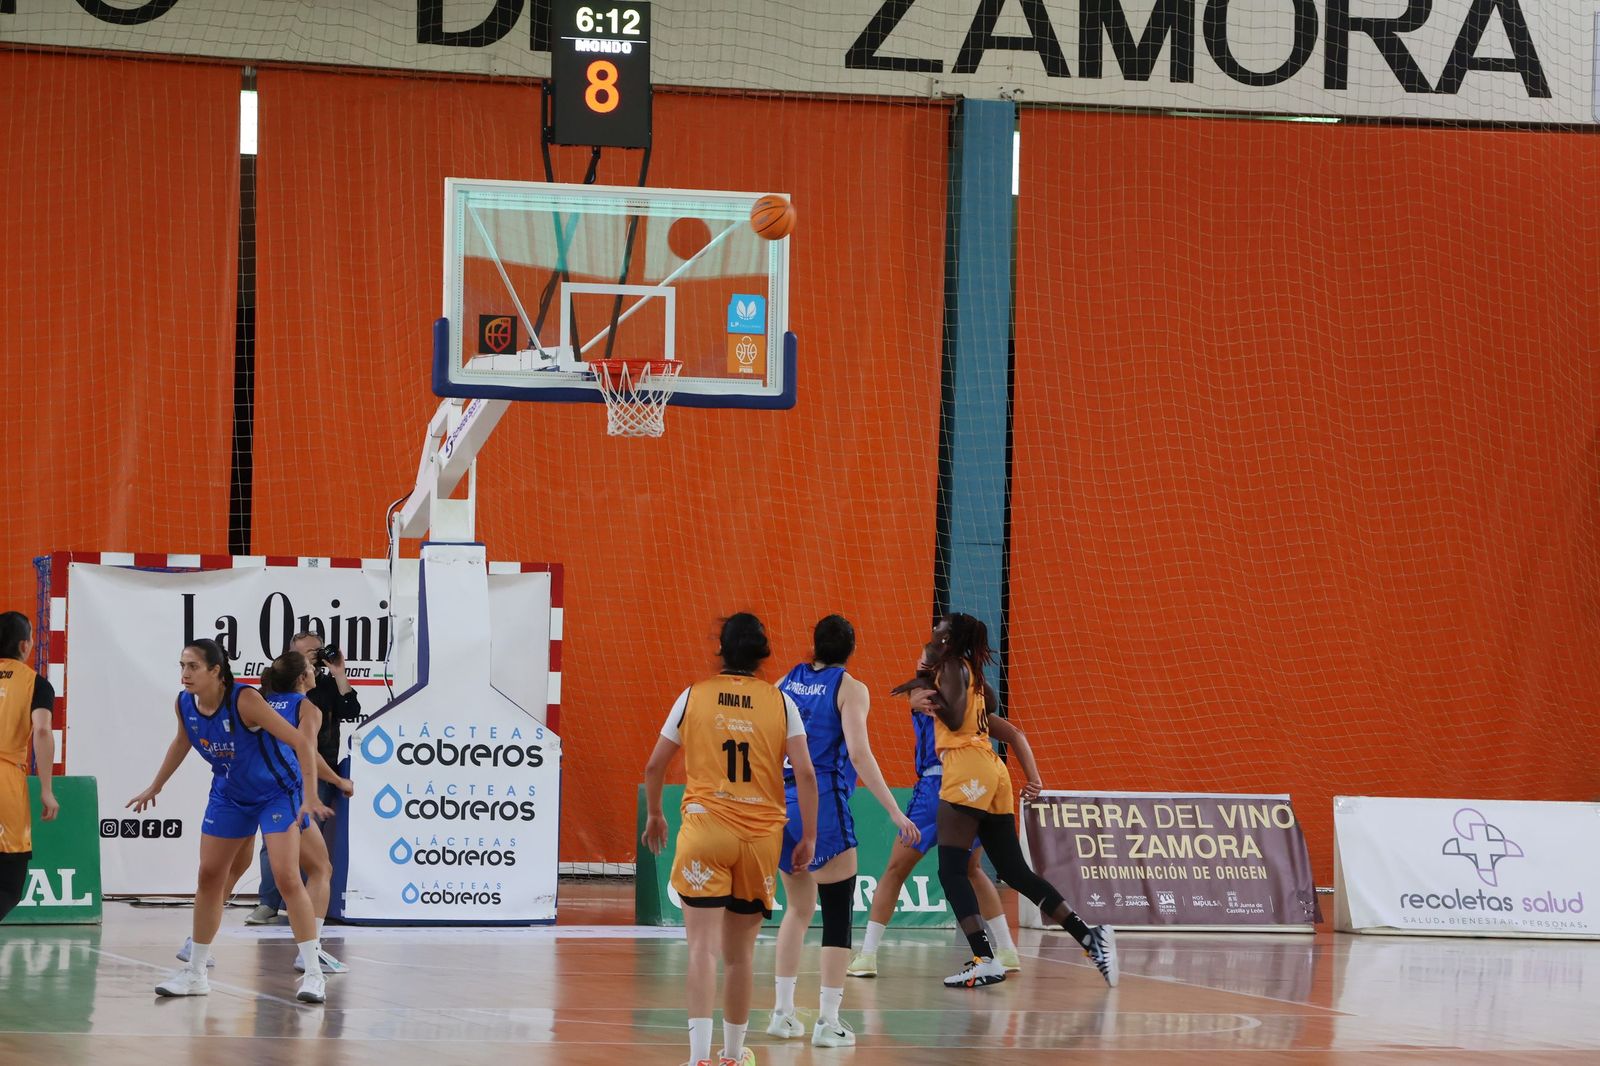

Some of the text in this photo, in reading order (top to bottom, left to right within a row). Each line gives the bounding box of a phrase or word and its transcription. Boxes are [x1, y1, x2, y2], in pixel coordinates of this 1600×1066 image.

[575, 6, 641, 35] 6:12
[575, 40, 632, 54] MONDO
[845, 0, 1552, 98] ZAMORA
[585, 60, 620, 113] 8
[718, 692, 753, 709] AINA M.
[399, 722, 544, 740] LÁCTEAS
[397, 739, 543, 767] cobreros
[722, 739, 752, 782] 11
[407, 781, 536, 796] LÁCTEAS
[405, 796, 535, 821] cobreros
[1031, 803, 1295, 829] TIERRA DEL VINO
[416, 835, 516, 847] LÁCTEAS
[1075, 834, 1263, 859] DE ZAMORA
[414, 846, 516, 866] cobreros
[1081, 863, 1268, 880] DENOMINACIÓN DE ORIGEN
[422, 881, 502, 890] LÁCTEAS
[420, 889, 502, 905] cobreros
[1400, 888, 1584, 914] recoletas salud
